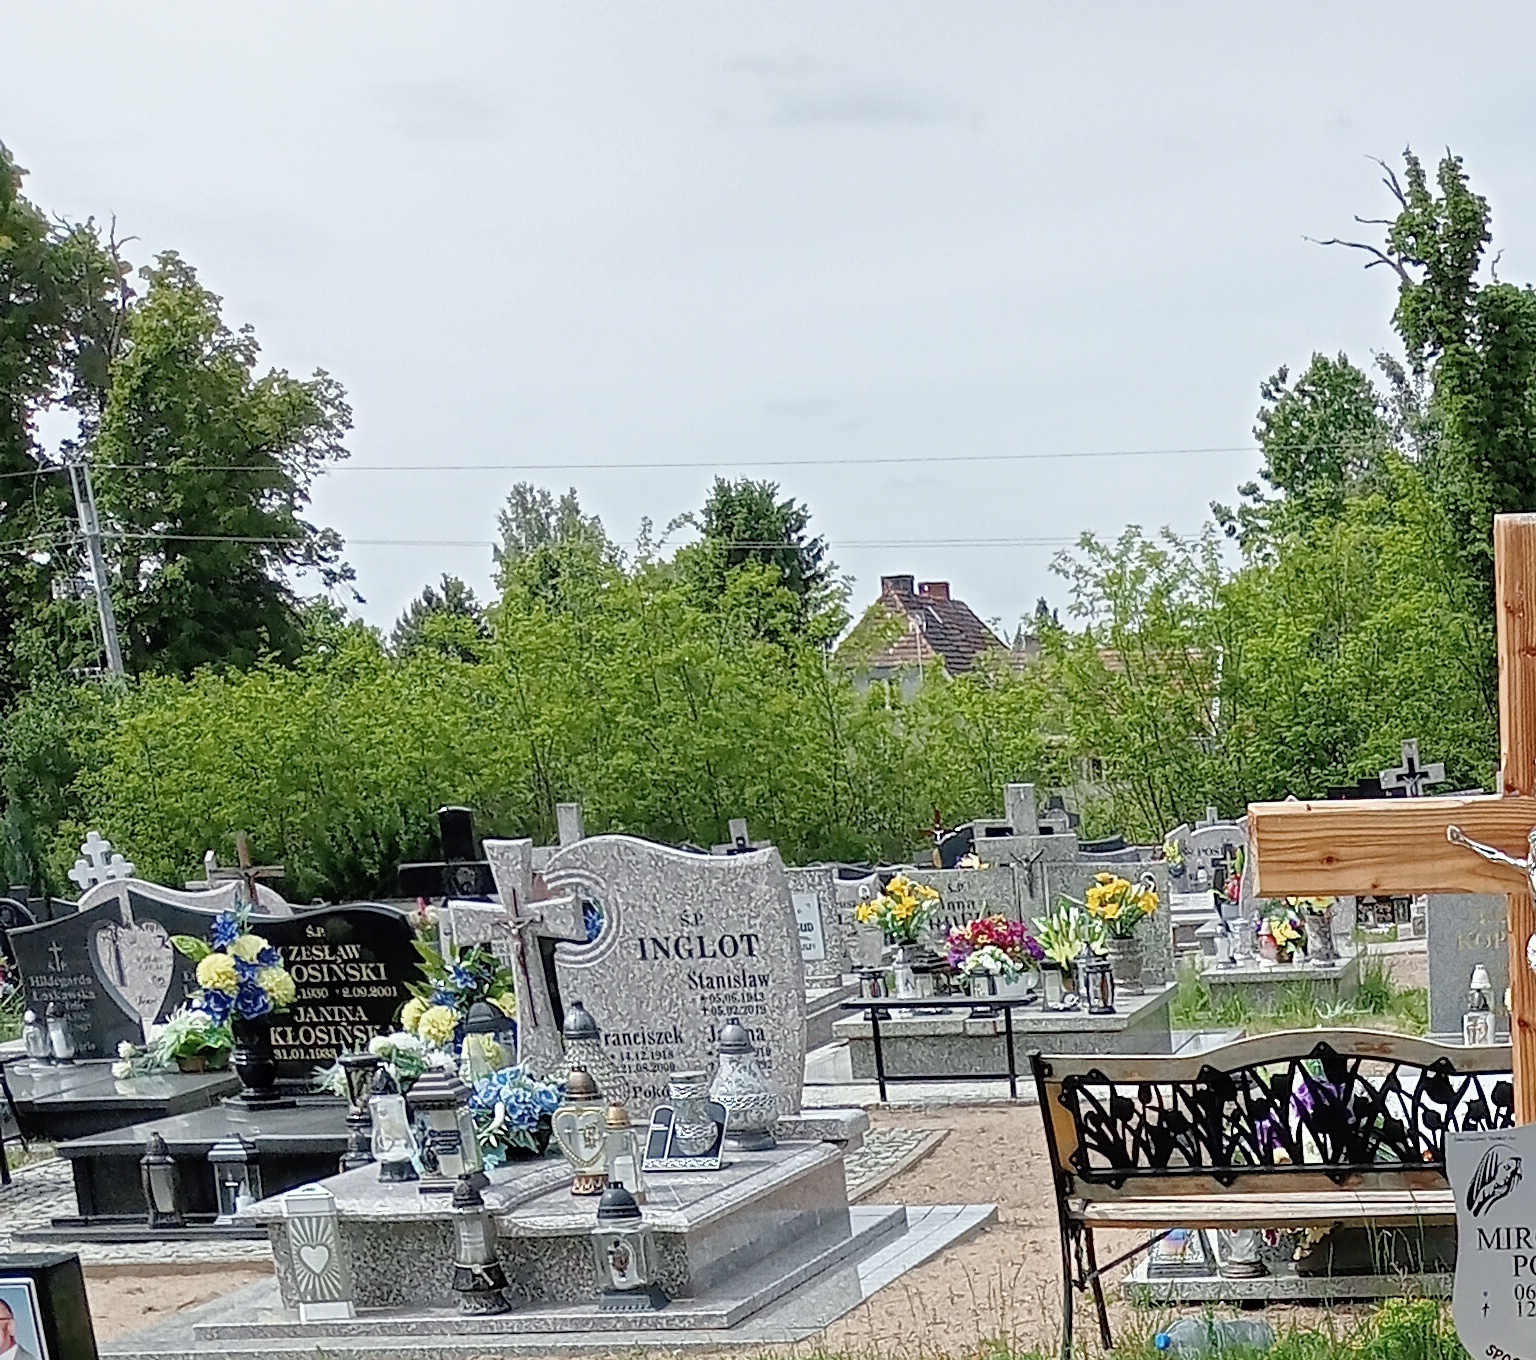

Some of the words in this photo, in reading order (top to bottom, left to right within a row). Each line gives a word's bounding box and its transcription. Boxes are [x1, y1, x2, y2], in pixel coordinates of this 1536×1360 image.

[638, 933, 760, 961] INGLOT
[688, 969, 770, 991] Stanisław
[294, 1006, 369, 1022] JANINA
[269, 1022, 396, 1046] KŁOSIŃSK
[597, 1024, 684, 1047] ranciszek
